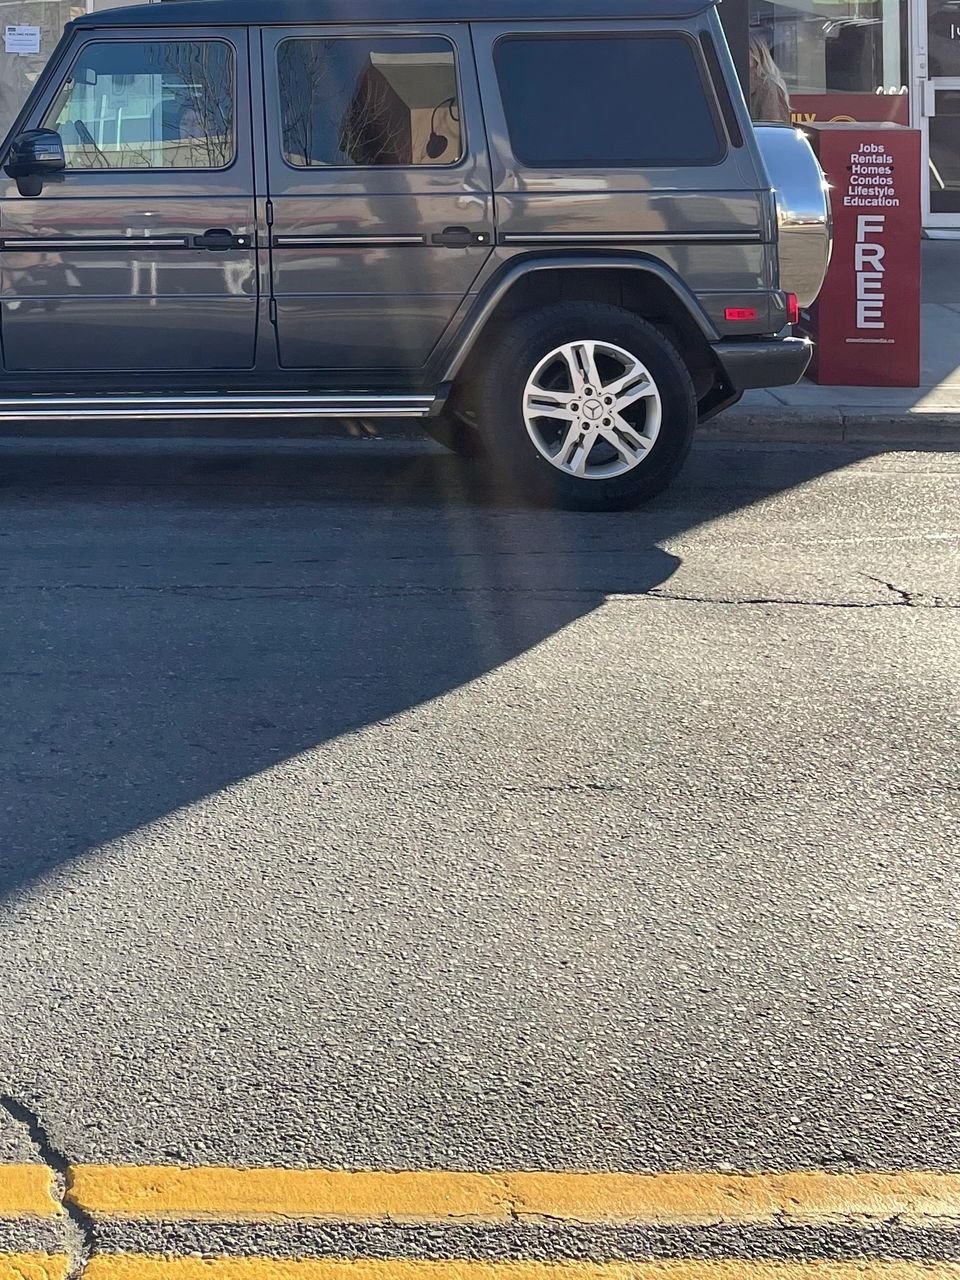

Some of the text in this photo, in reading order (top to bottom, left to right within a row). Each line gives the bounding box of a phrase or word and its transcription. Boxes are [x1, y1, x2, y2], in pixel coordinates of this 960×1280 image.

[858, 143, 884, 153] Jobs
[850, 153, 893, 164] Rentals
[851, 165, 892, 174] Homes
[850, 175, 893, 185] Condos
[848, 185, 895, 197] Lifestyle
[843, 196, 900, 207] Education
[854, 215, 886, 329] FREE
